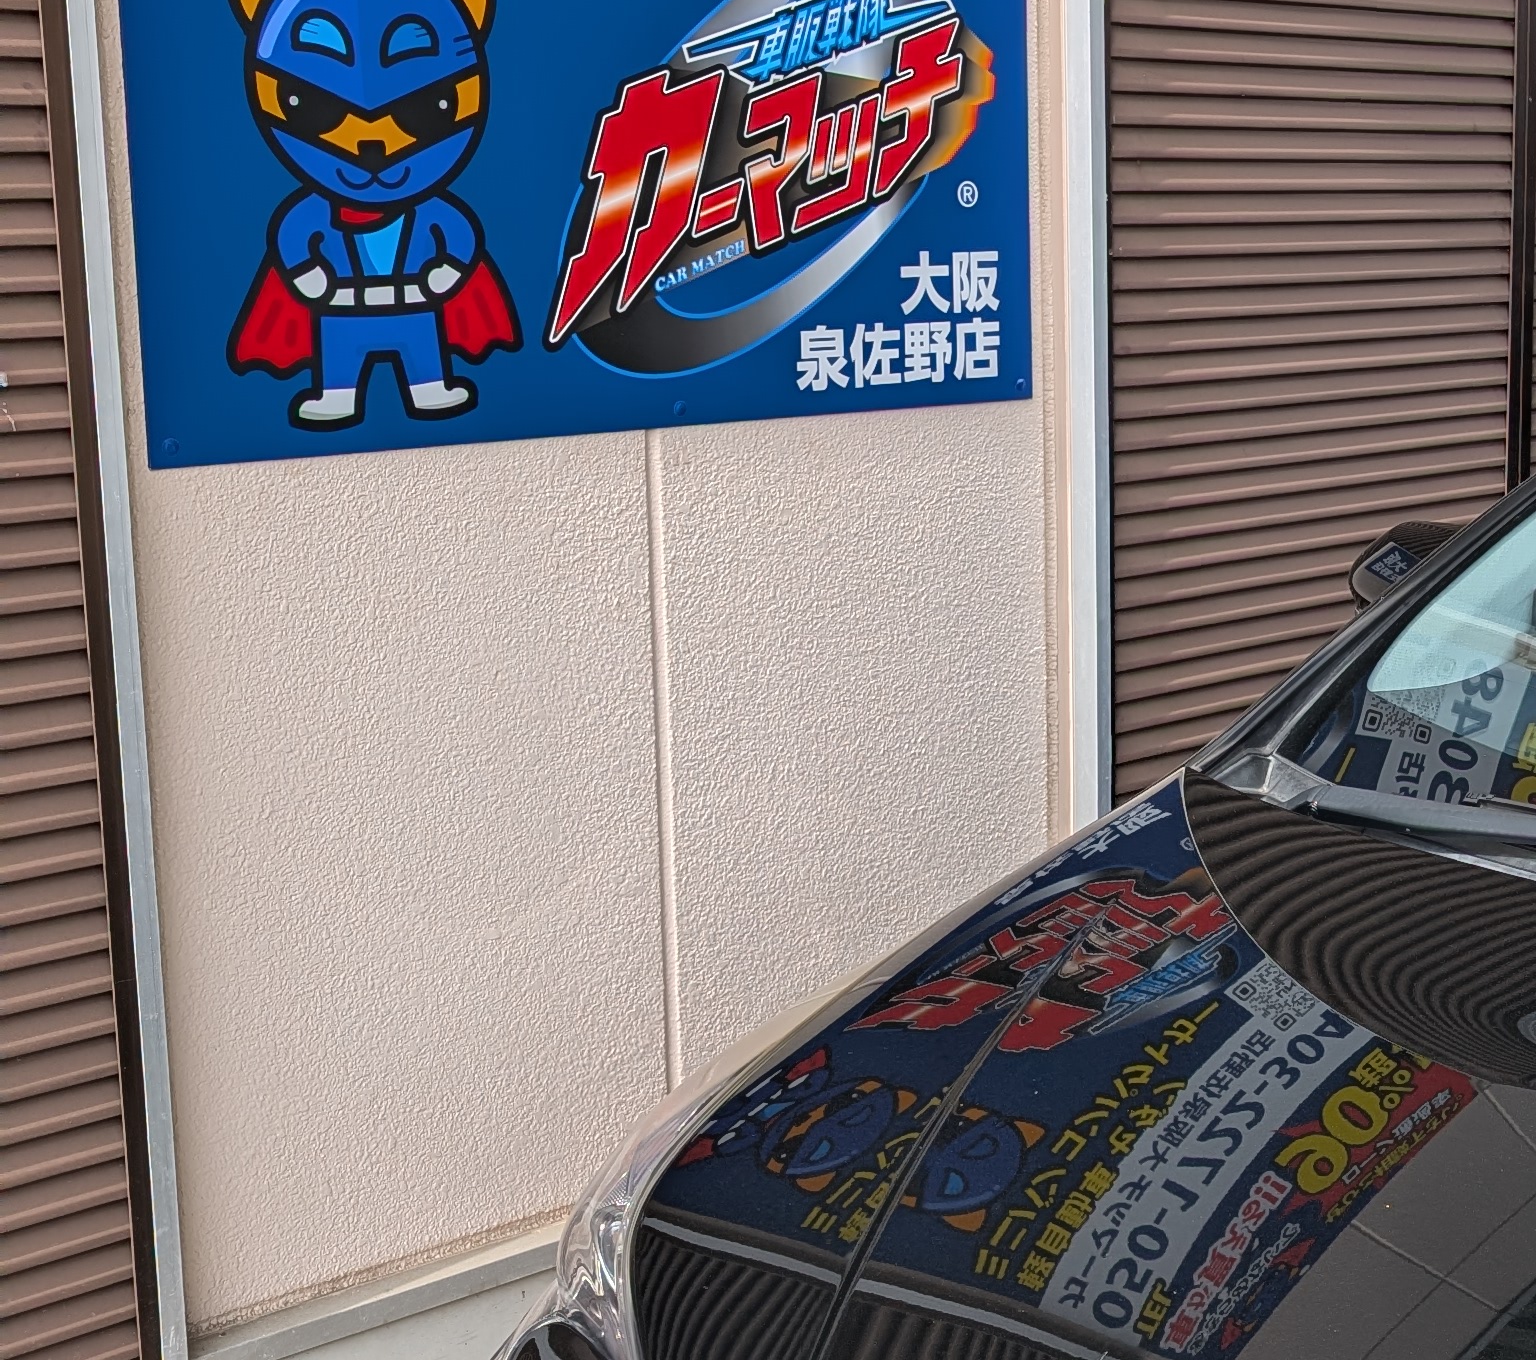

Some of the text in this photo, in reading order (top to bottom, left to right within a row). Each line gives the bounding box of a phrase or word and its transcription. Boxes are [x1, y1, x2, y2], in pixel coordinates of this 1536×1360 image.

[551, 17, 962, 345] カーマッチ
[654, 239, 746, 293] CAR MATCH
[898, 251, 1001, 315] 大阪
[795, 319, 1001, 391] 泉佐野店
